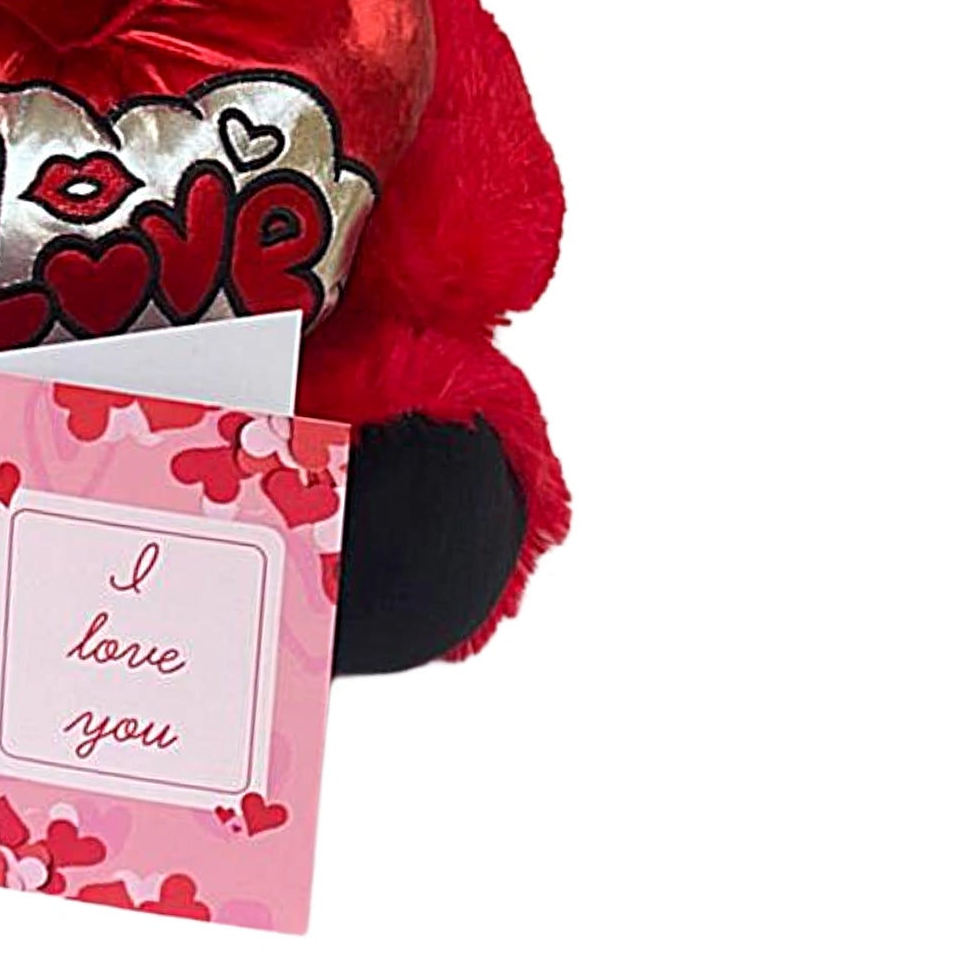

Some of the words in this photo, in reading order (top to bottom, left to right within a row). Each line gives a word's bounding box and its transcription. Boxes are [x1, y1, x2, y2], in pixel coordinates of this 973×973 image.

[109, 542, 160, 594] I
[66, 611, 188, 676] love
[63, 709, 180, 758] you
